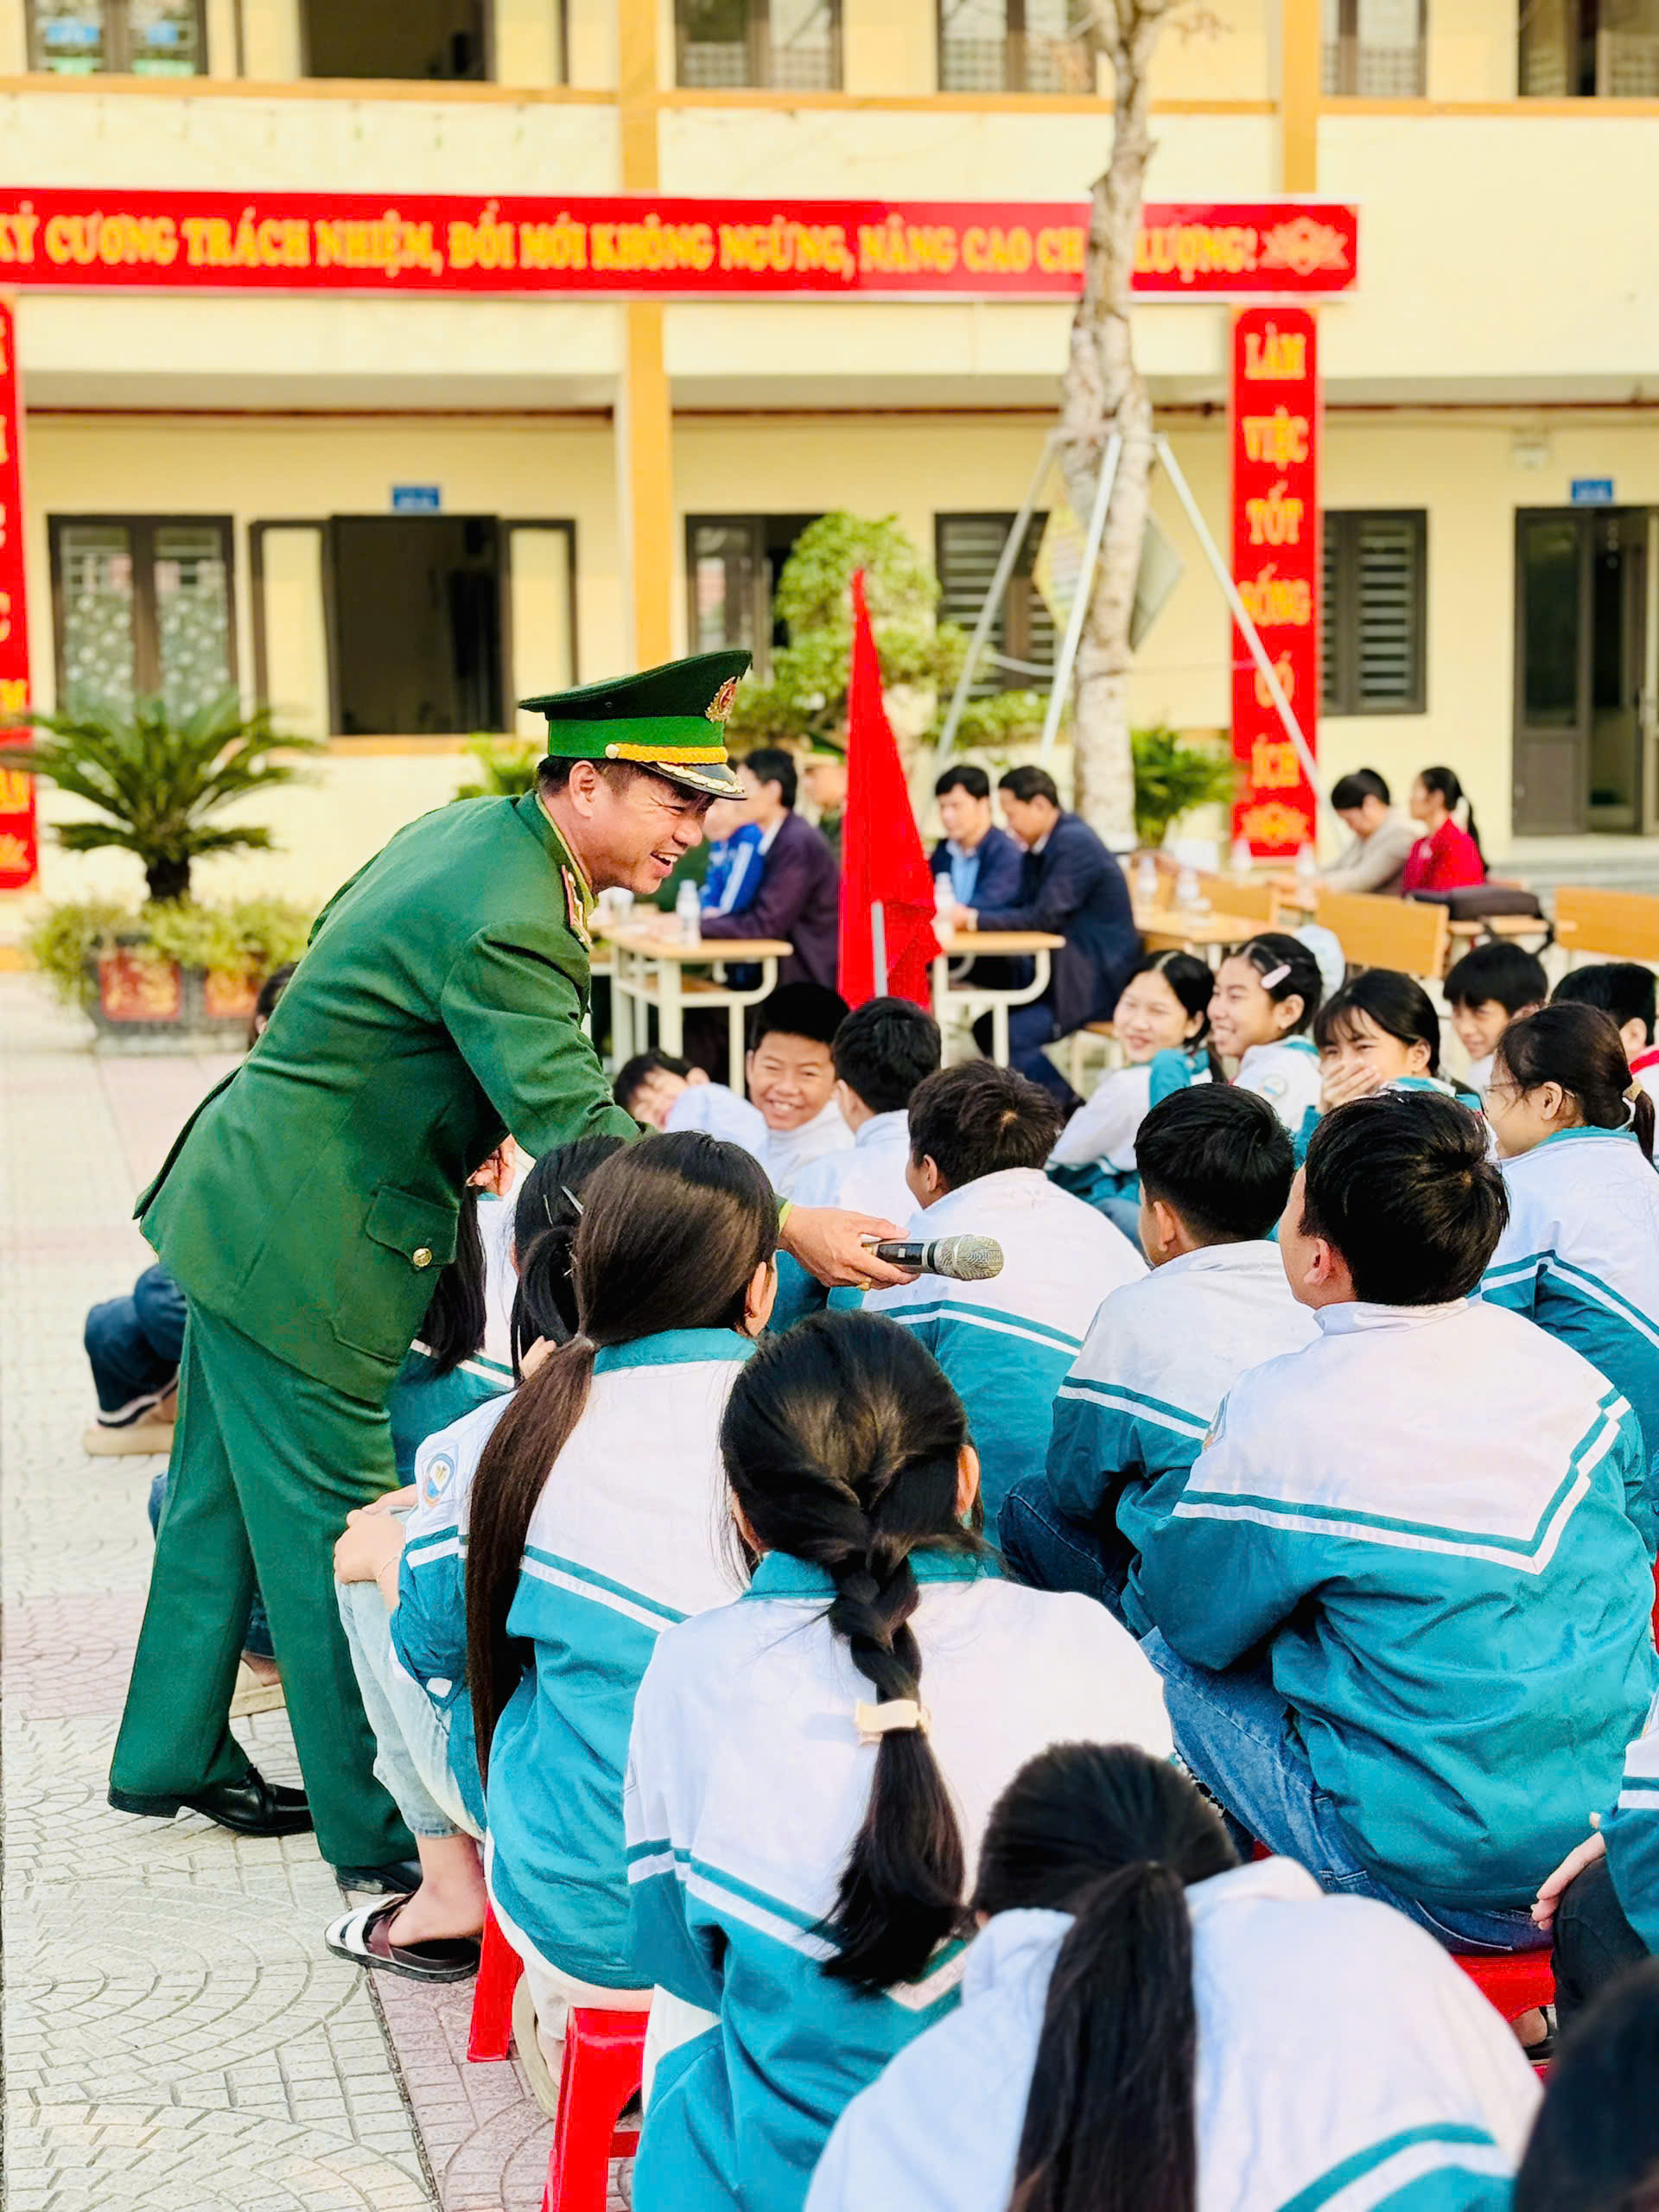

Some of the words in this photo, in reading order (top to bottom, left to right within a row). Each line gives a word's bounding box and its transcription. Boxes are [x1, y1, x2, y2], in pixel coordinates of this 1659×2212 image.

[45, 210, 178, 265] CƯƠNG
[181, 207, 309, 267] TRÁCH
[315, 209, 442, 276] NHIỆM,
[448, 200, 514, 269] ĐỔI
[518, 211, 587, 269] MỚI
[590, 213, 715, 270] KHÔNG
[719, 214, 855, 281] NGỪNG,
[858, 214, 957, 272] NÂNG
[962, 226, 1033, 273] CAO
[1038, 226, 1086, 273] CH
[1244, 321, 1306, 380] LÀM
[1242, 404, 1309, 472] VIỆC
[1245, 479, 1304, 545] TỐT
